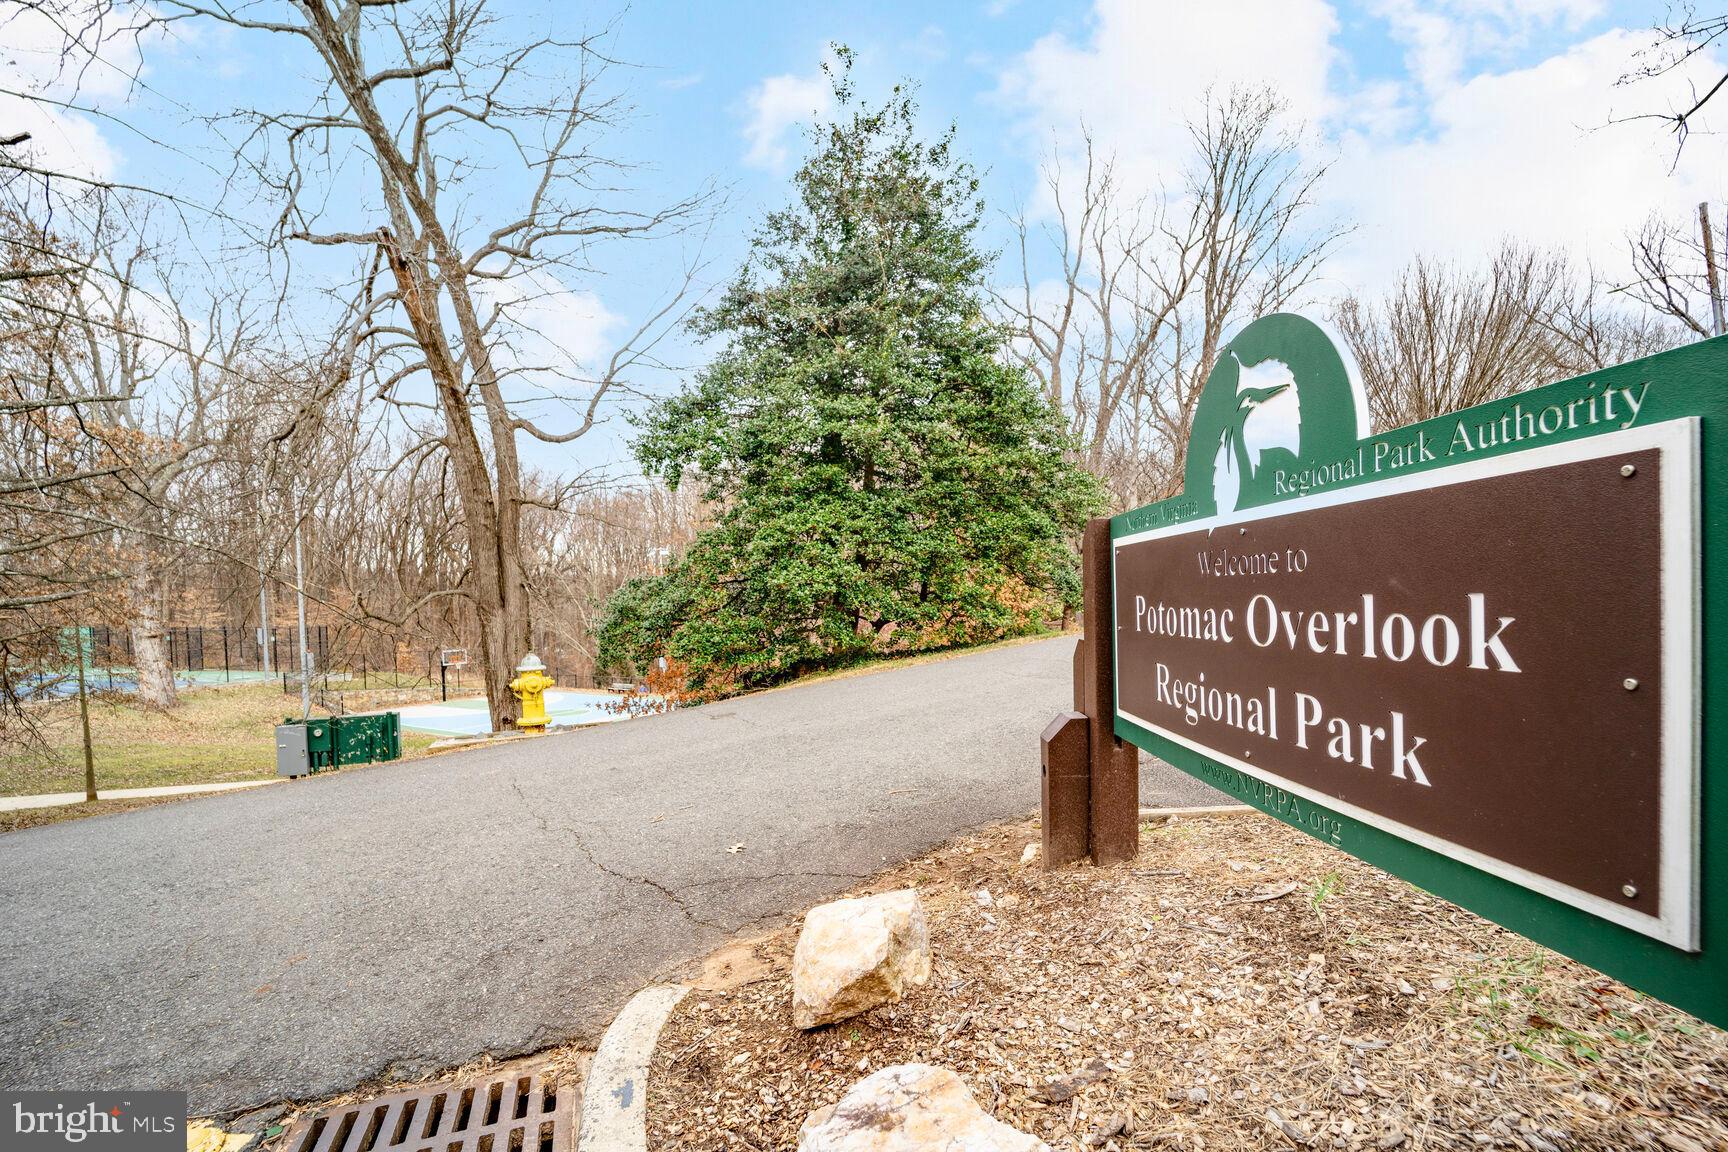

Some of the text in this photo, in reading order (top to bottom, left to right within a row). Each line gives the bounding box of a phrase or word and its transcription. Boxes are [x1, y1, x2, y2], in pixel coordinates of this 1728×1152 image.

[1160, 500, 1199, 525] Virginia
[1274, 444, 1365, 497] Regional
[1373, 430, 1436, 475] Park
[1447, 381, 1652, 456] Authority
[1198, 546, 1308, 577] Welcome to
[1135, 592, 1522, 674] Potomac Overlook
[1155, 662, 1432, 788] Regional Park
[1200, 761, 1343, 848] www.NVRPA.org
